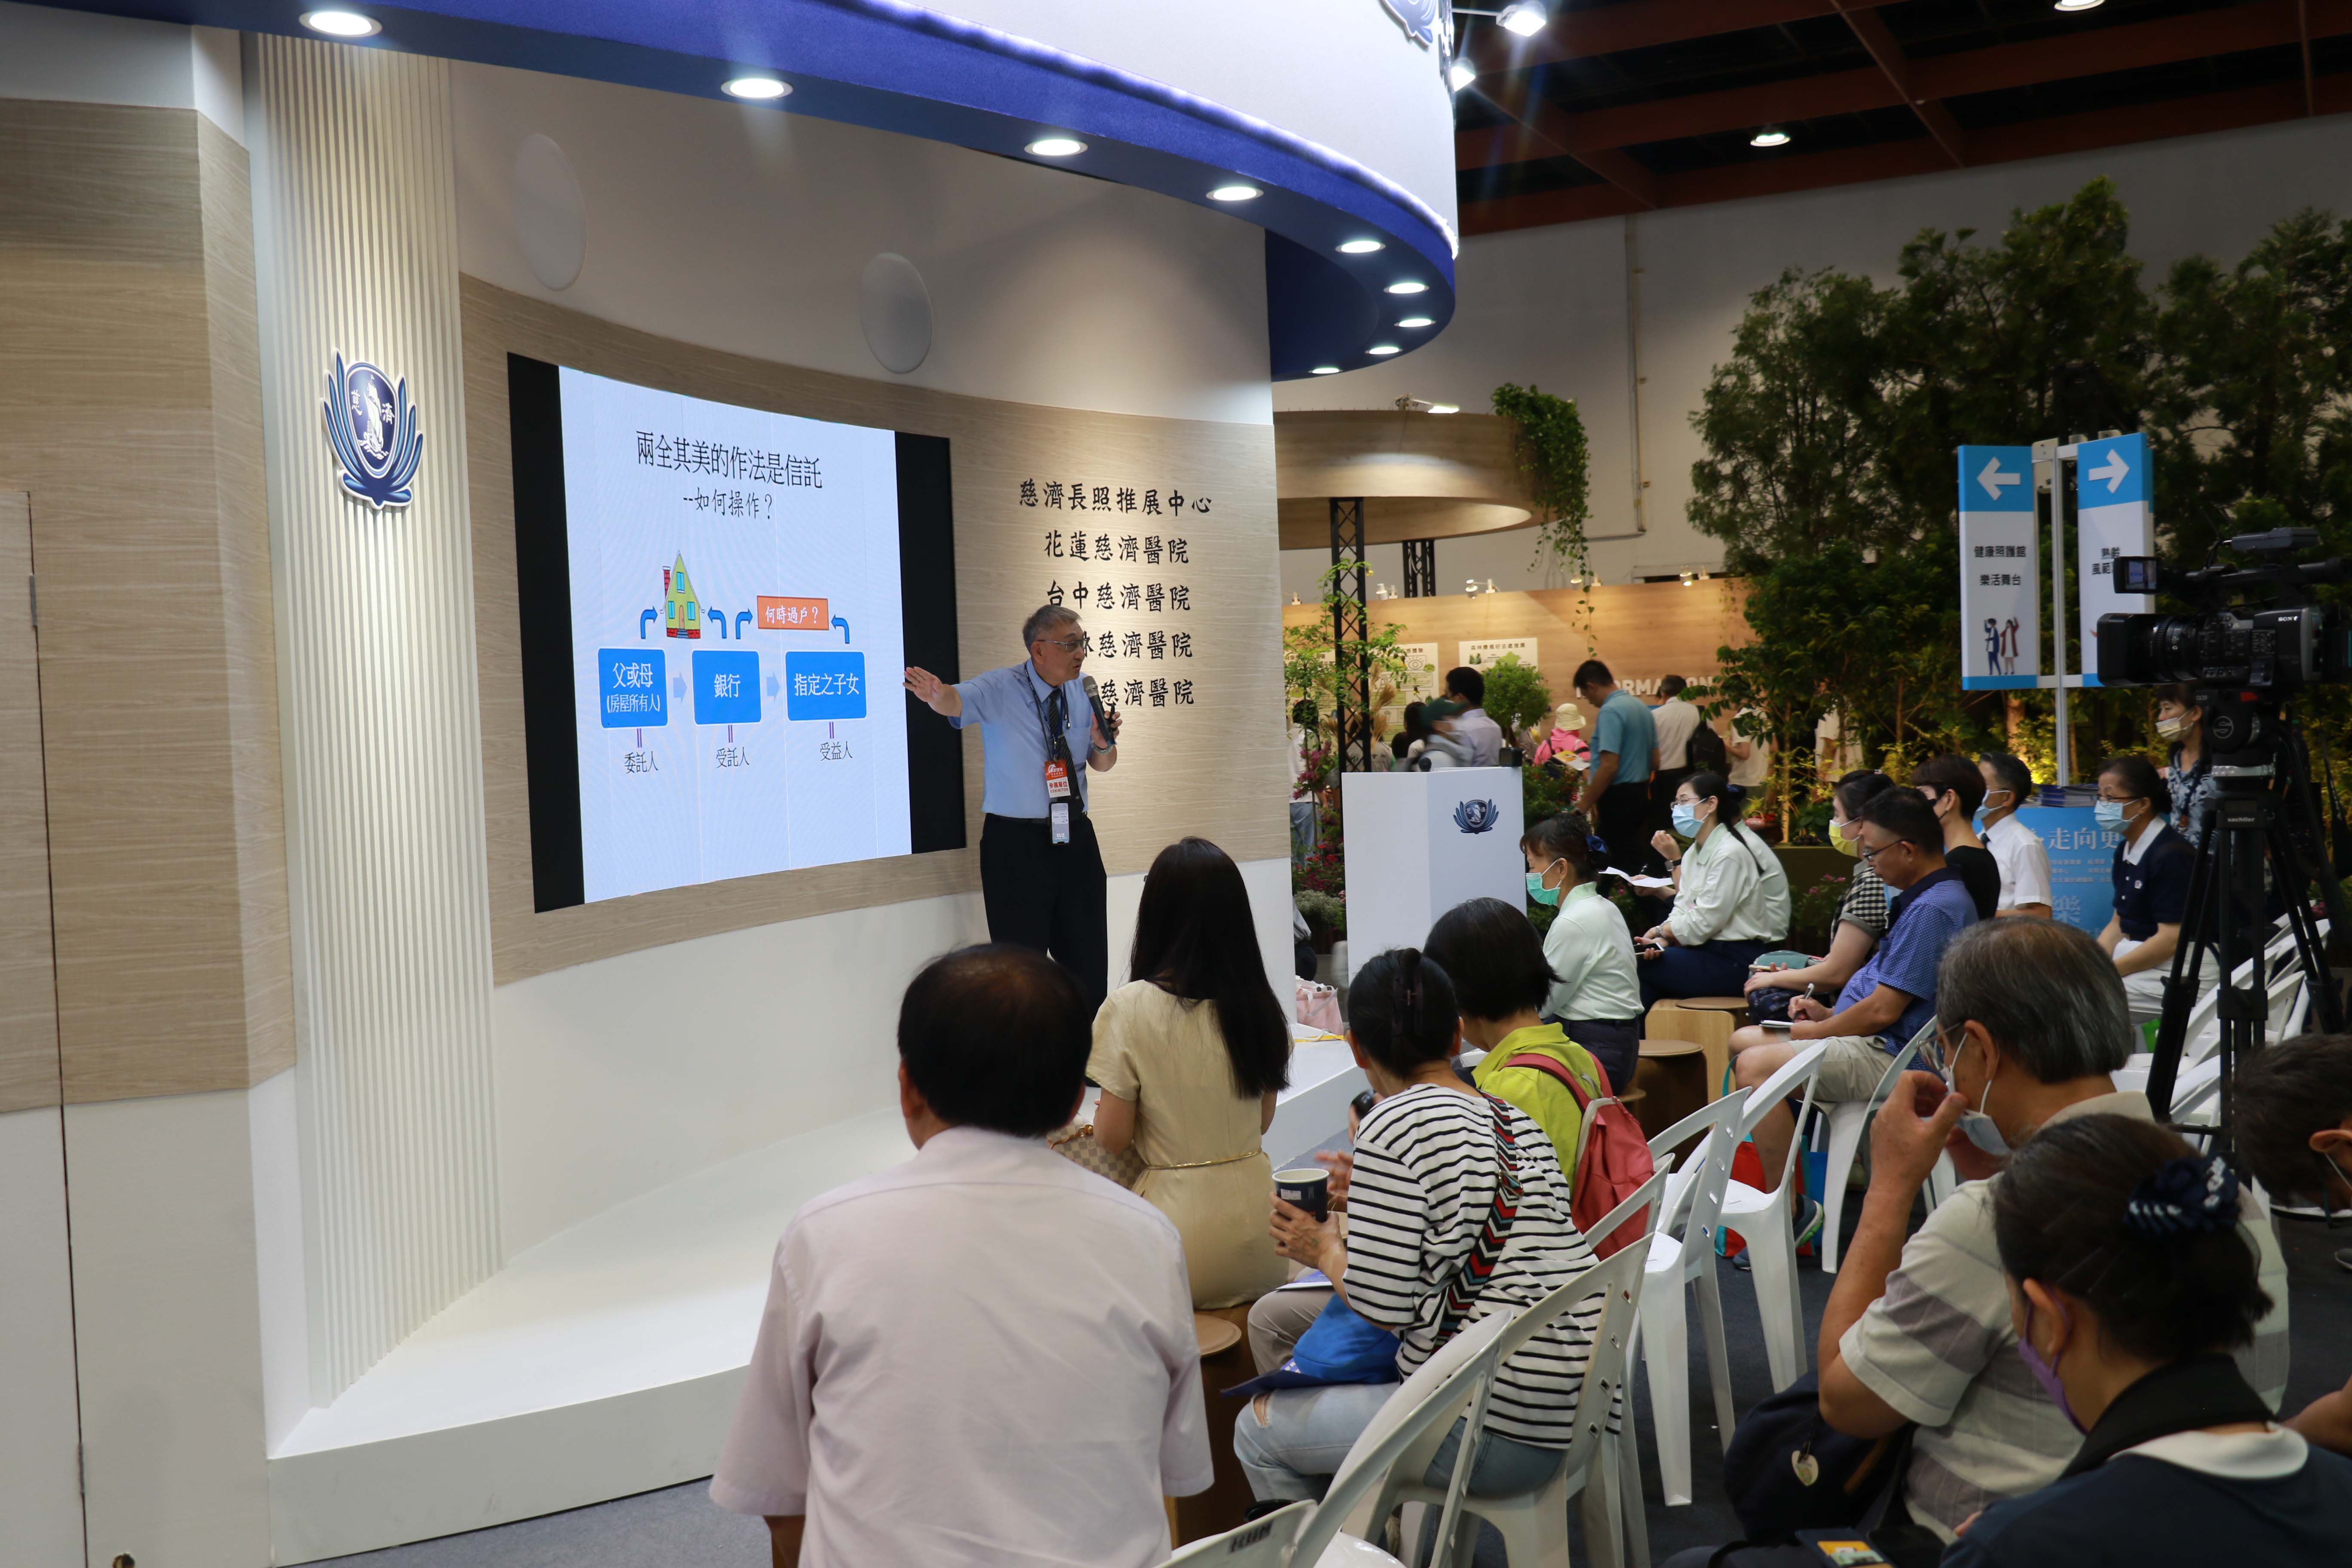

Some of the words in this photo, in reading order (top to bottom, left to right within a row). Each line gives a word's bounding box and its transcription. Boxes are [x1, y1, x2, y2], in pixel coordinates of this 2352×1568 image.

[636, 430, 823, 489] 兩全其美的作法是信託
[1020, 478, 1212, 517] 慈濟長照推展中心
[1044, 530, 1189, 565] 花蓮慈濟醫院
[1974, 546, 2025, 557] 健康照護館
[1980, 574, 2021, 585] 樂活舞台
[2092, 562, 2114, 575] 風範
[1047, 579, 1191, 612] 台中慈濟醫院
[612, 662, 653, 689] 父或母
[714, 674, 740, 698] 銀行
[794, 672, 859, 697] 指定之子女
[606, 693, 660, 714] (房屋所有人)
[1101, 678, 1194, 707] 慈濟醫院
[624, 750, 658, 773] 委託人
[716, 746, 750, 768] 受託人
[819, 741, 853, 762] 受益人
[2037, 827, 2119, 850] 走向更
